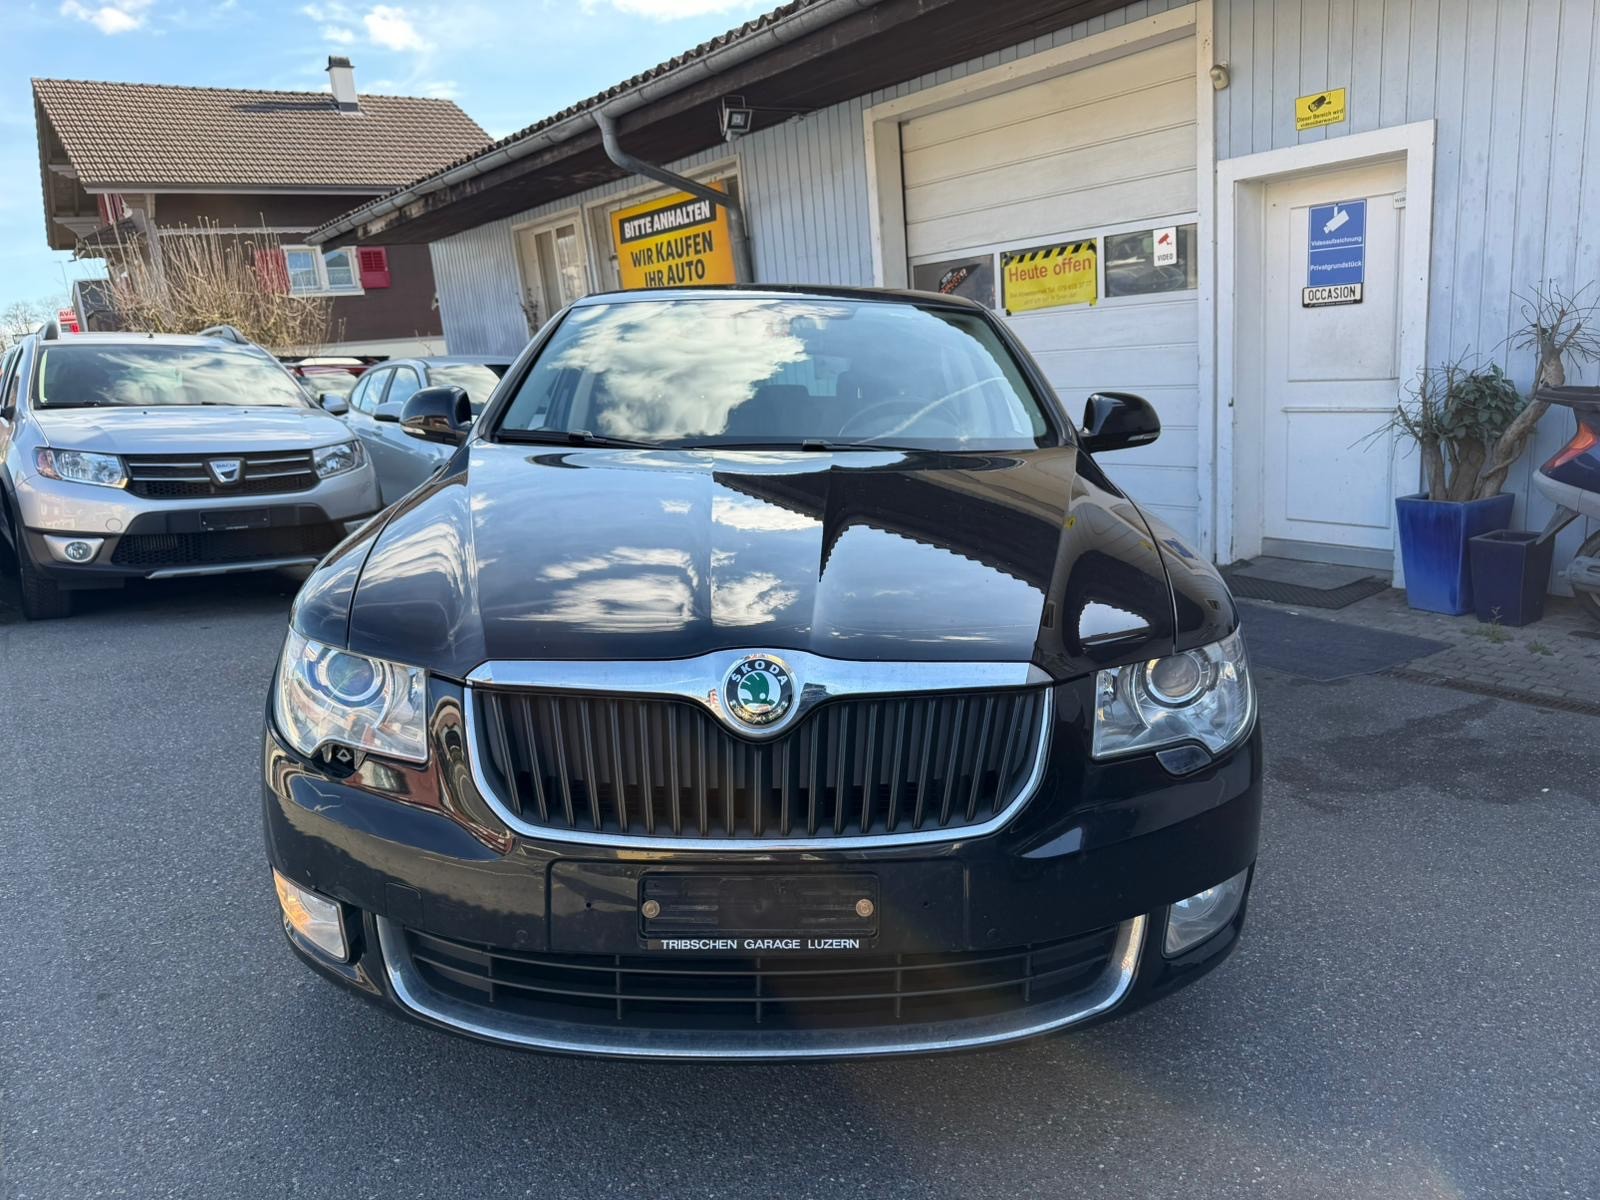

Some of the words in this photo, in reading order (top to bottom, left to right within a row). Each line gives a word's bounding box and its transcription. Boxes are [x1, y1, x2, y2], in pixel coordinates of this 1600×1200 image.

[623, 217, 652, 239] BITTE
[653, 200, 711, 231] ANHALTEN
[630, 247, 654, 268] WIR
[655, 230, 714, 264] KAUFEN
[1157, 252, 1173, 262] VIDEO
[644, 270, 665, 288] IHR
[667, 258, 706, 286] AUTO
[1008, 265, 1048, 283] Heute
[1053, 256, 1092, 276] offen
[1308, 285, 1356, 302] OCCASION
[661, 939, 737, 950] TRIBSCHEN
[744, 939, 801, 950] GARAGE
[808, 938, 860, 949] LUZERN
